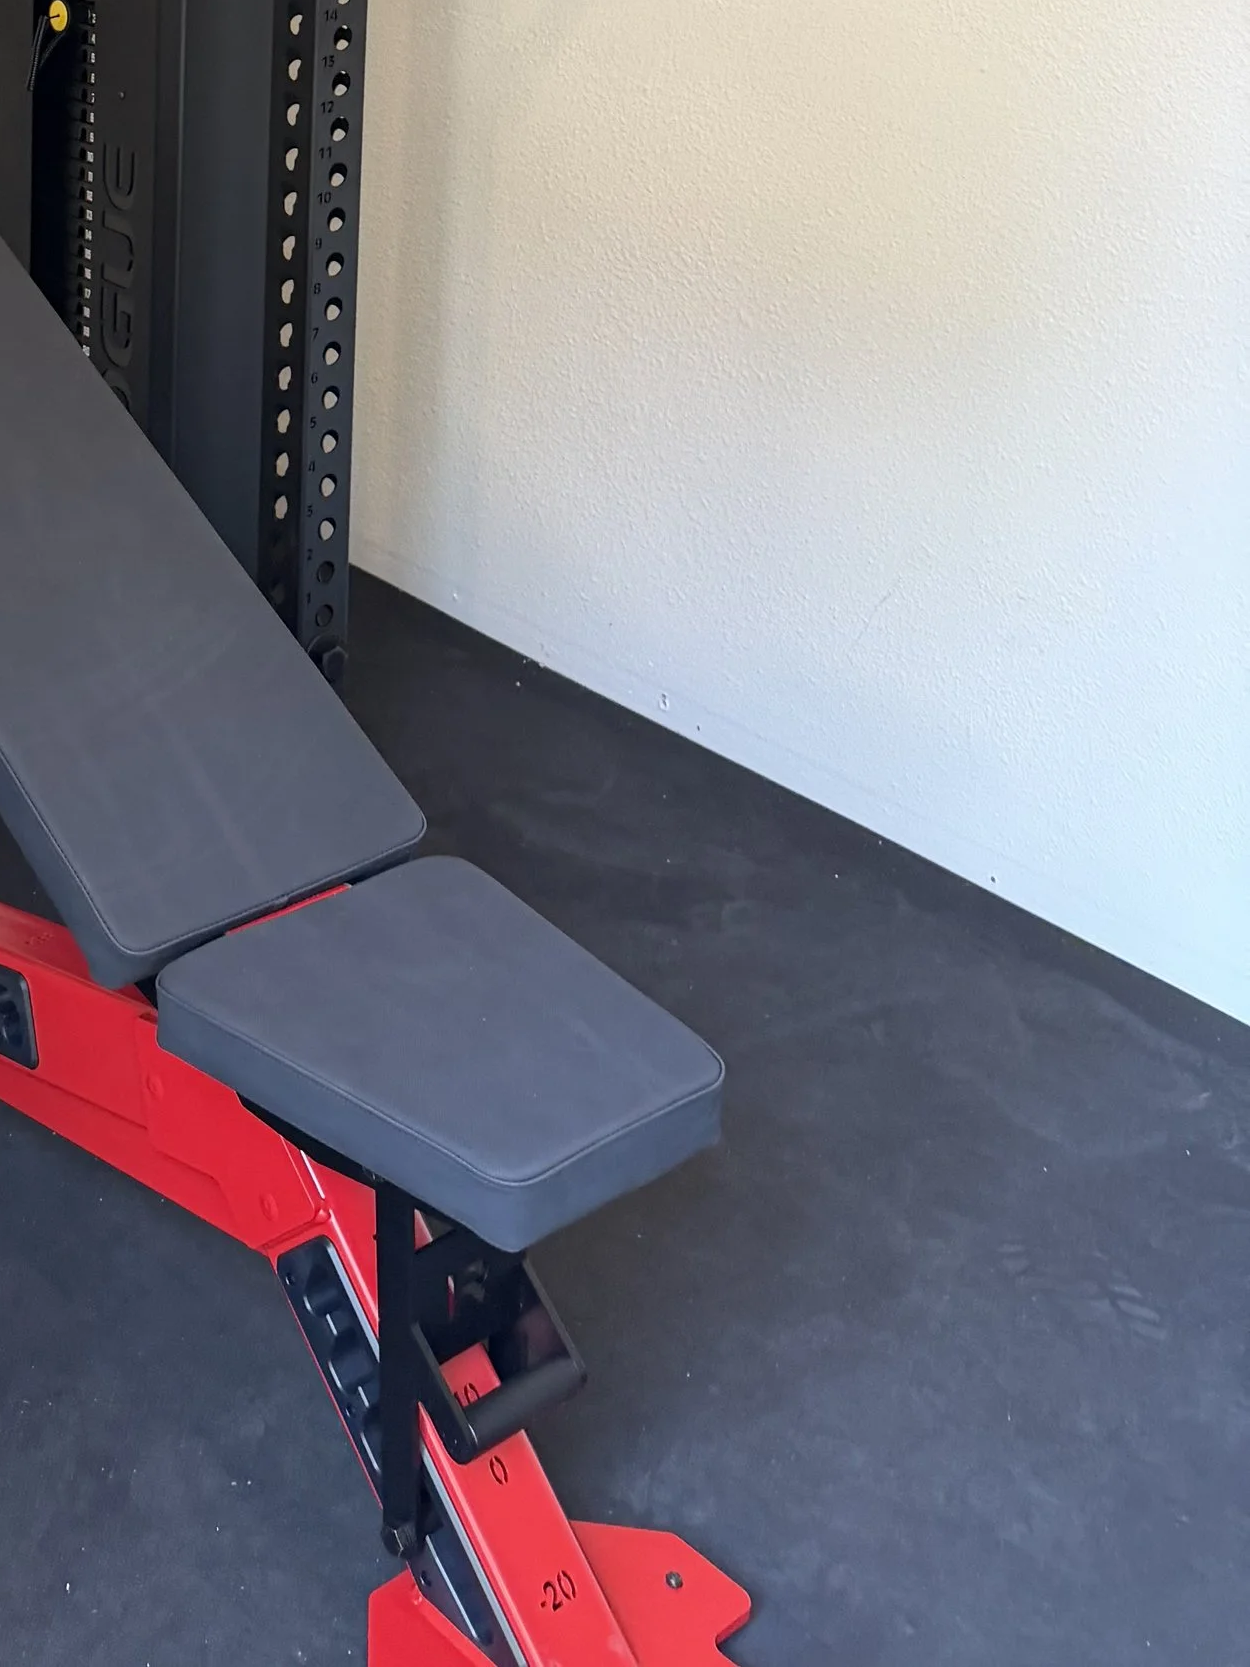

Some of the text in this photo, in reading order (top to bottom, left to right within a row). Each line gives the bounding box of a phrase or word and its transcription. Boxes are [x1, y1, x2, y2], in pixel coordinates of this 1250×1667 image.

[324, 9, 338, 22] 14
[320, 101, 334, 114] 12
[318, 147, 332, 159] 11
[317, 192, 331, 205] 10
[315, 238, 322, 249] 9
[313, 283, 321, 294] 8
[312, 328, 319, 340] 7
[311, 372, 318, 384] 6
[489, 1455, 509, 1485] 0
[540, 1570, 577, 1612] -20
